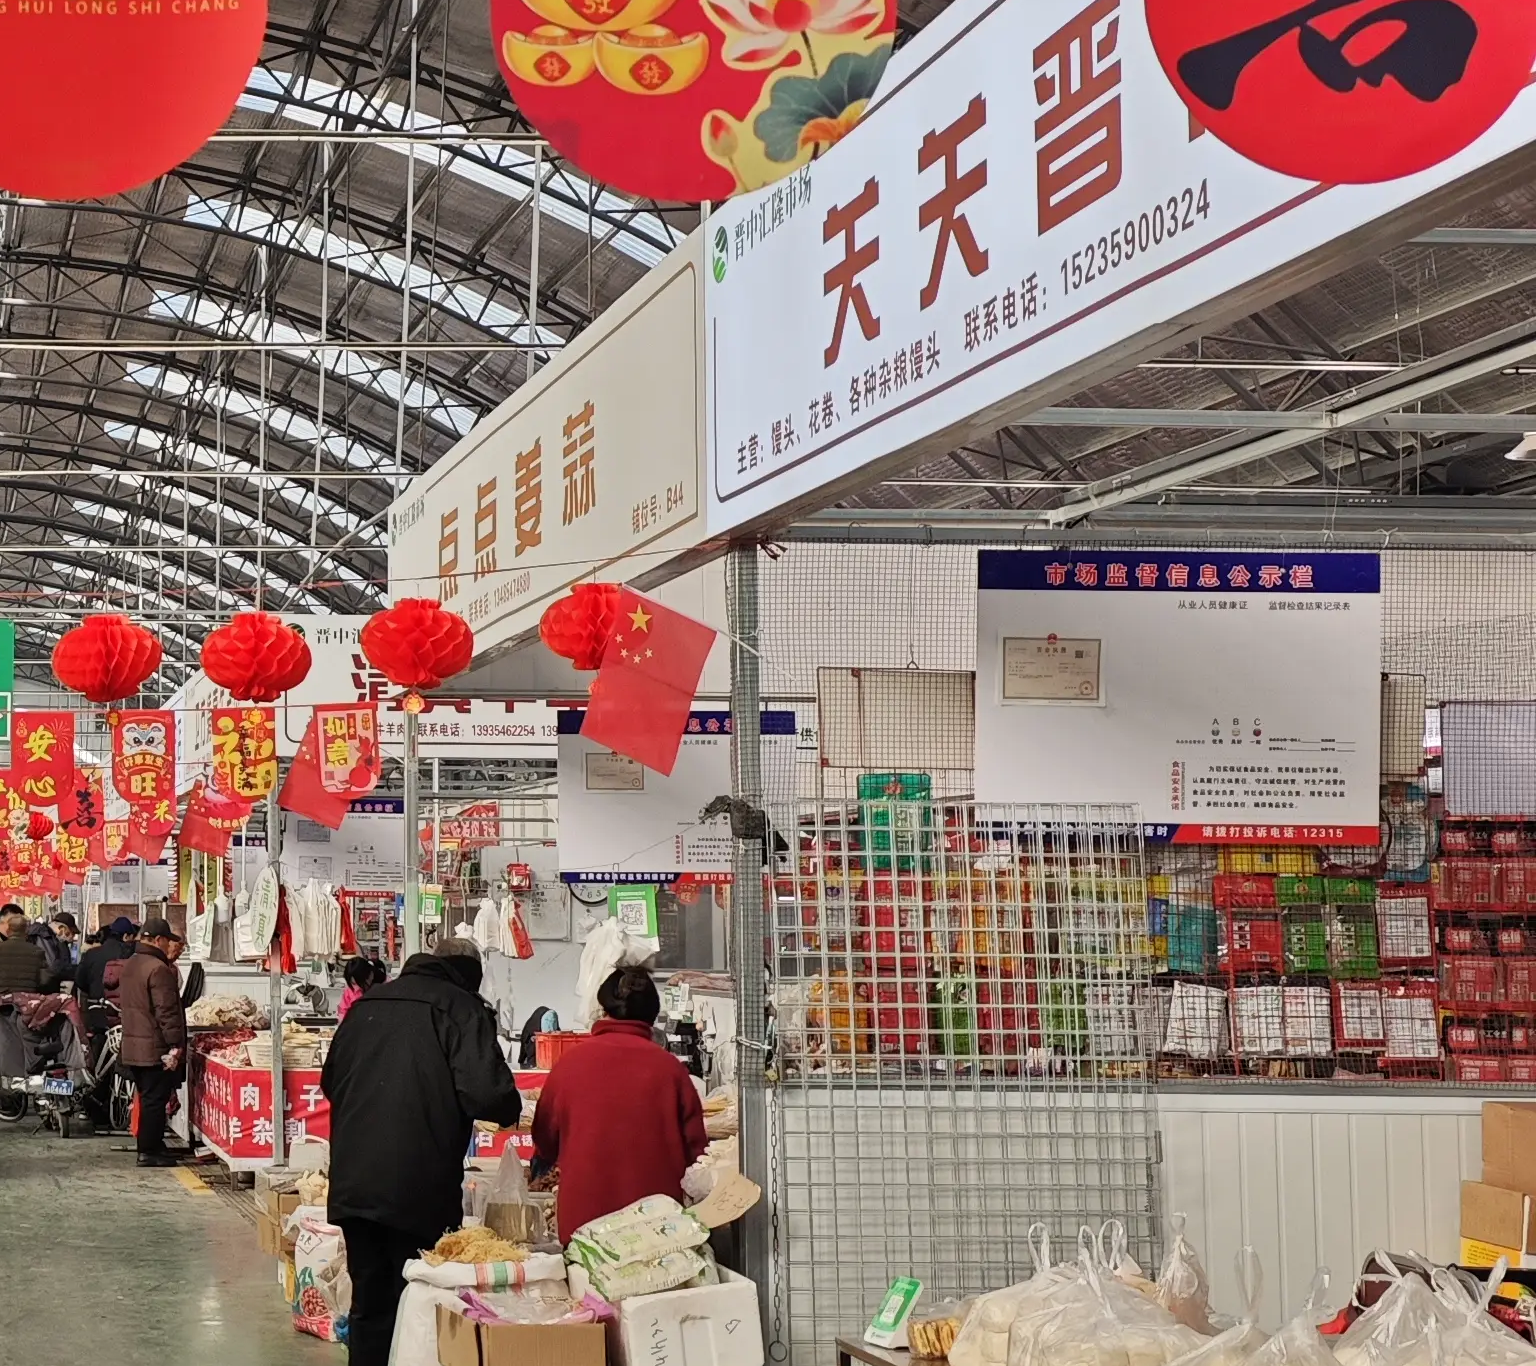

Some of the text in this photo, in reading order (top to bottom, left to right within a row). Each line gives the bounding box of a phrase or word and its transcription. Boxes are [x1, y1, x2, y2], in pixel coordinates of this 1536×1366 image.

[18, 0, 54, 14] HUI
[64, 1, 118, 15] LONG
[128, 0, 161, 15] SHI
[733, 163, 812, 262] 晋中汇隆市场
[963, 178, 1211, 354] 联系电话：15235900324
[438, 398, 596, 604] 点点姜蒜
[1044, 562, 1314, 589] 市场监督信息公示栏
[1177, 599, 1249, 611] 从业人员健康证
[22, 725, 57, 798] 安心
[130, 771, 157, 797] 旺
